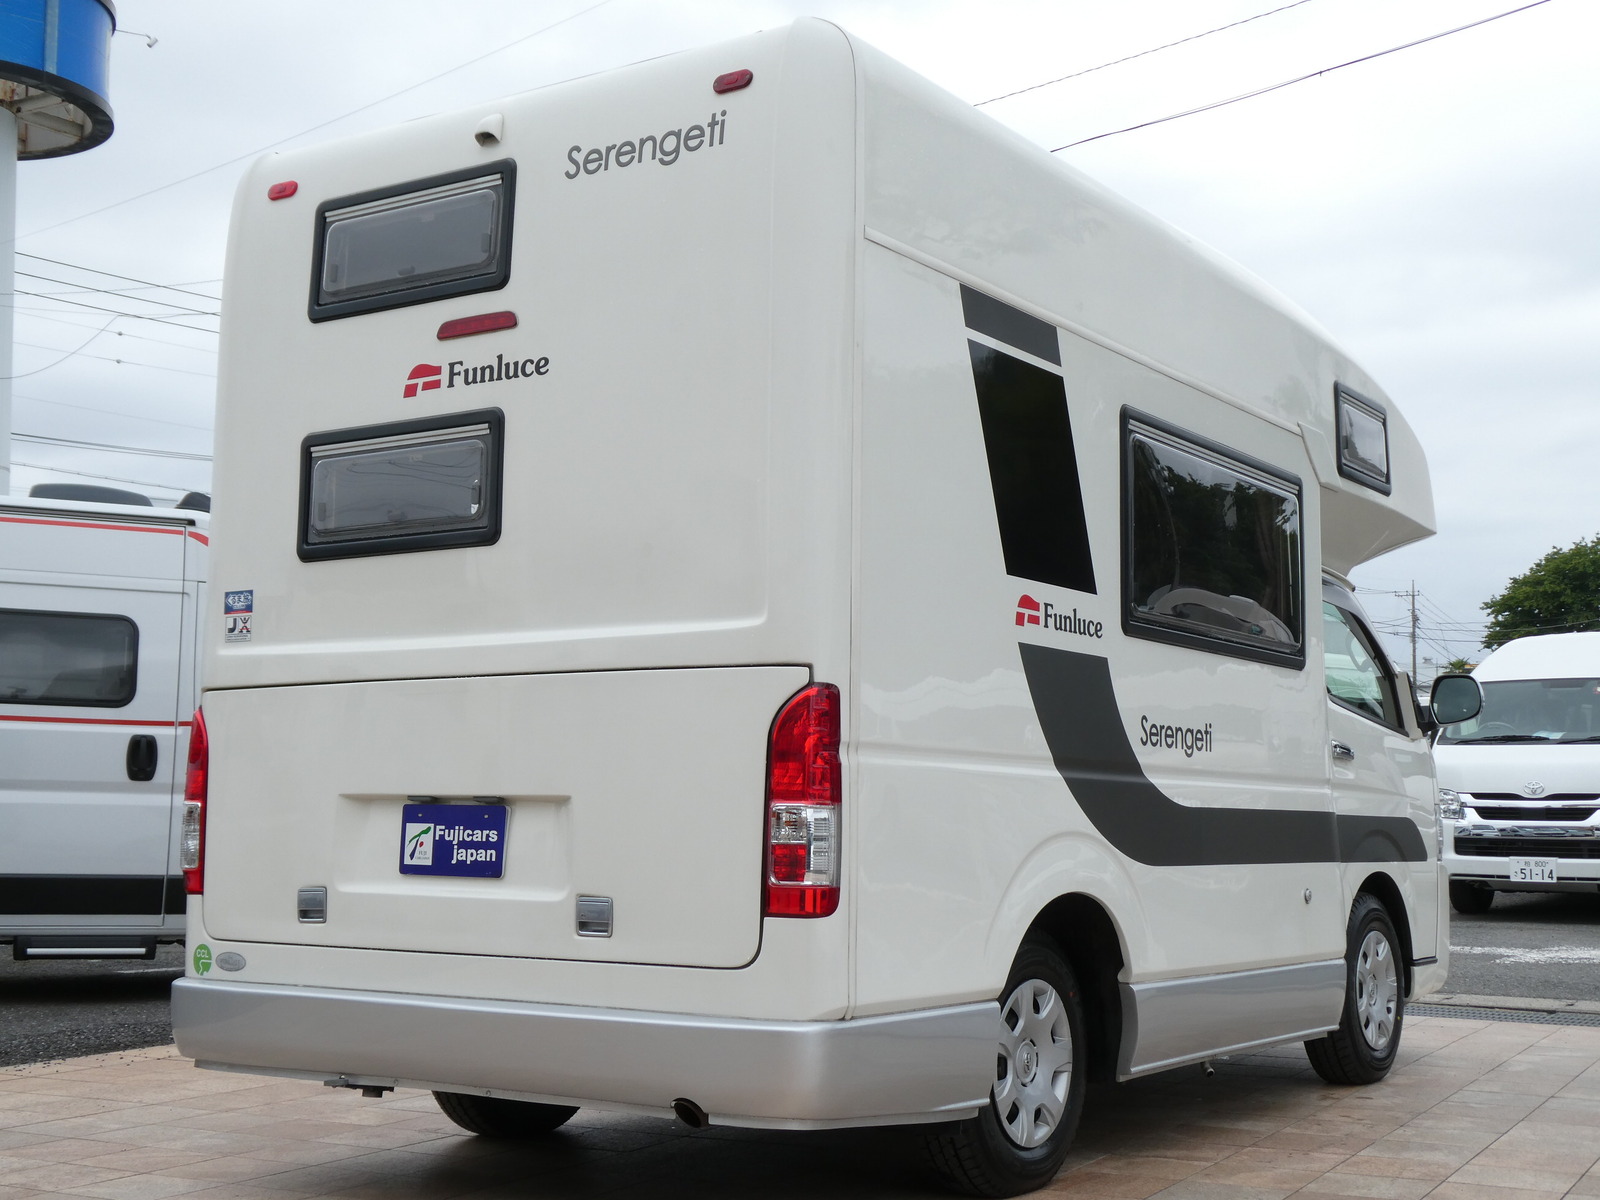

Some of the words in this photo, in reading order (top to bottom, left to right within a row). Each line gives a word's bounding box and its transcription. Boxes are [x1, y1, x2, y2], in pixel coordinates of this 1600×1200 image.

[564, 109, 727, 180] Serengeti
[446, 353, 550, 388] Funluce
[1043, 602, 1103, 639] Funluce
[1140, 714, 1212, 758] Serengeti
[435, 825, 498, 844] Fujicars
[451, 845, 496, 864] japan
[1520, 868, 1554, 881] 51-14
[196, 949, 209, 958] CCL
